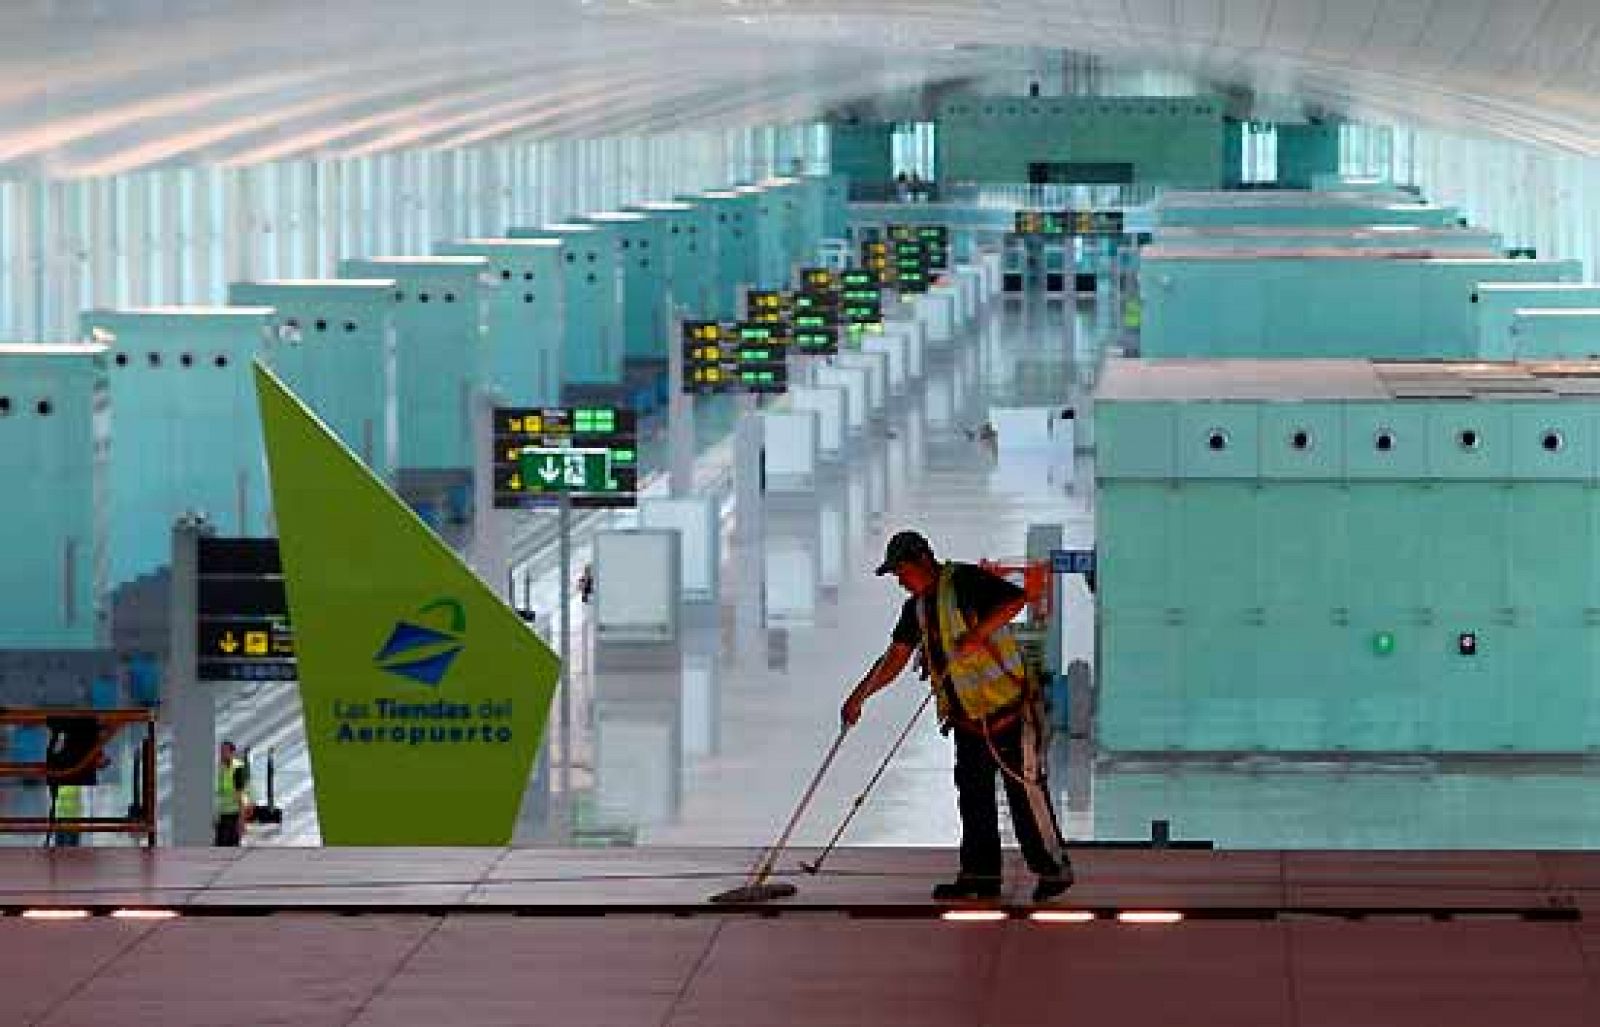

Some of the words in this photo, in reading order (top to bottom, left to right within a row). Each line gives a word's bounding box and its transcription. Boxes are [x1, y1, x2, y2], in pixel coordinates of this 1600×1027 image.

[334, 698, 370, 718] Las
[374, 698, 470, 718] Tiendas
[479, 698, 513, 718] del
[337, 723, 513, 744] Aeropuerto
